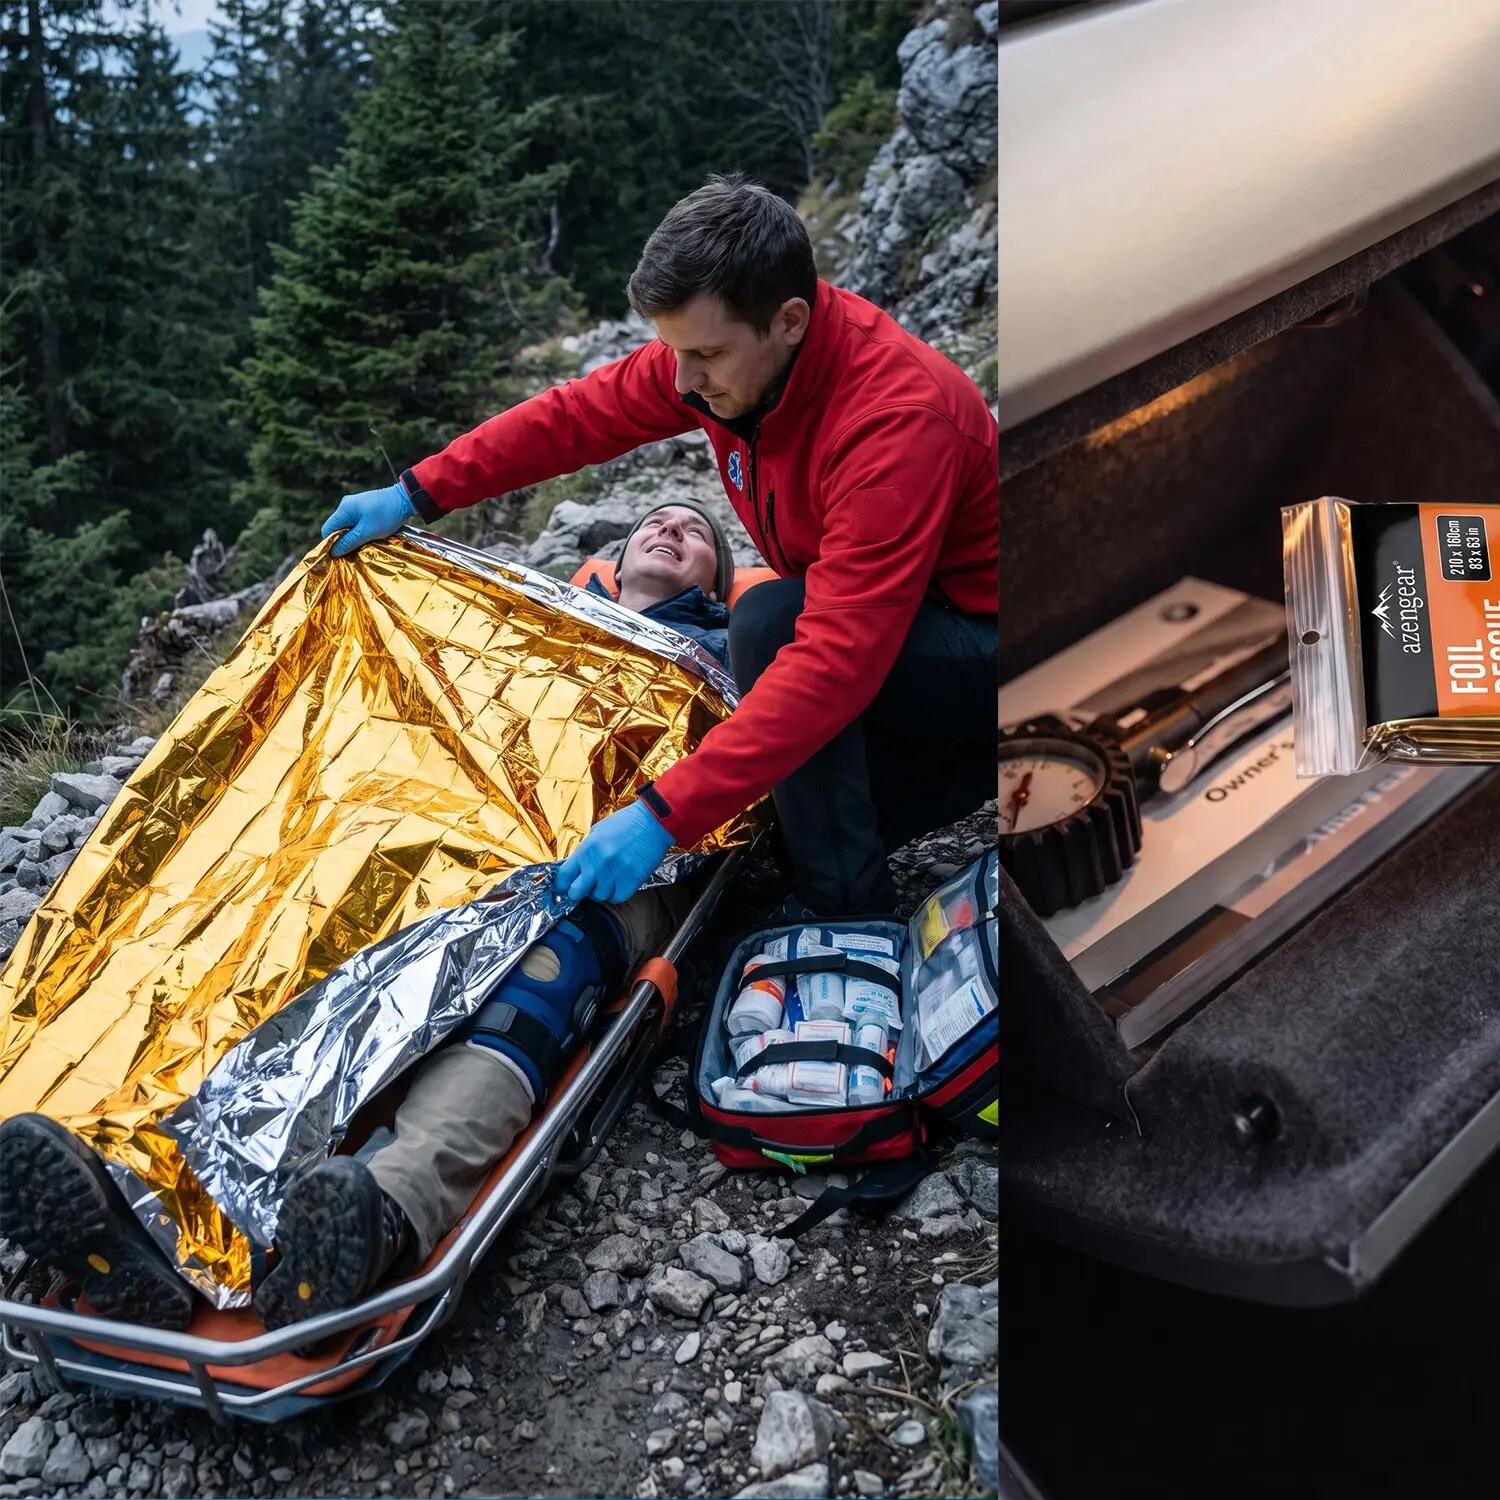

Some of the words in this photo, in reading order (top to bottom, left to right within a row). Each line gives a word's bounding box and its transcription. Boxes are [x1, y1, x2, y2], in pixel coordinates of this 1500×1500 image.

[1447, 520, 1462, 549] 160cm
[1466, 527, 1481, 536] in
[1467, 536, 1482, 549] 63
[1449, 558, 1466, 575] 210
[1469, 557, 1484, 570] 83
[1448, 638, 1489, 694] FOIL
[1205, 741, 1295, 802] Owner's
